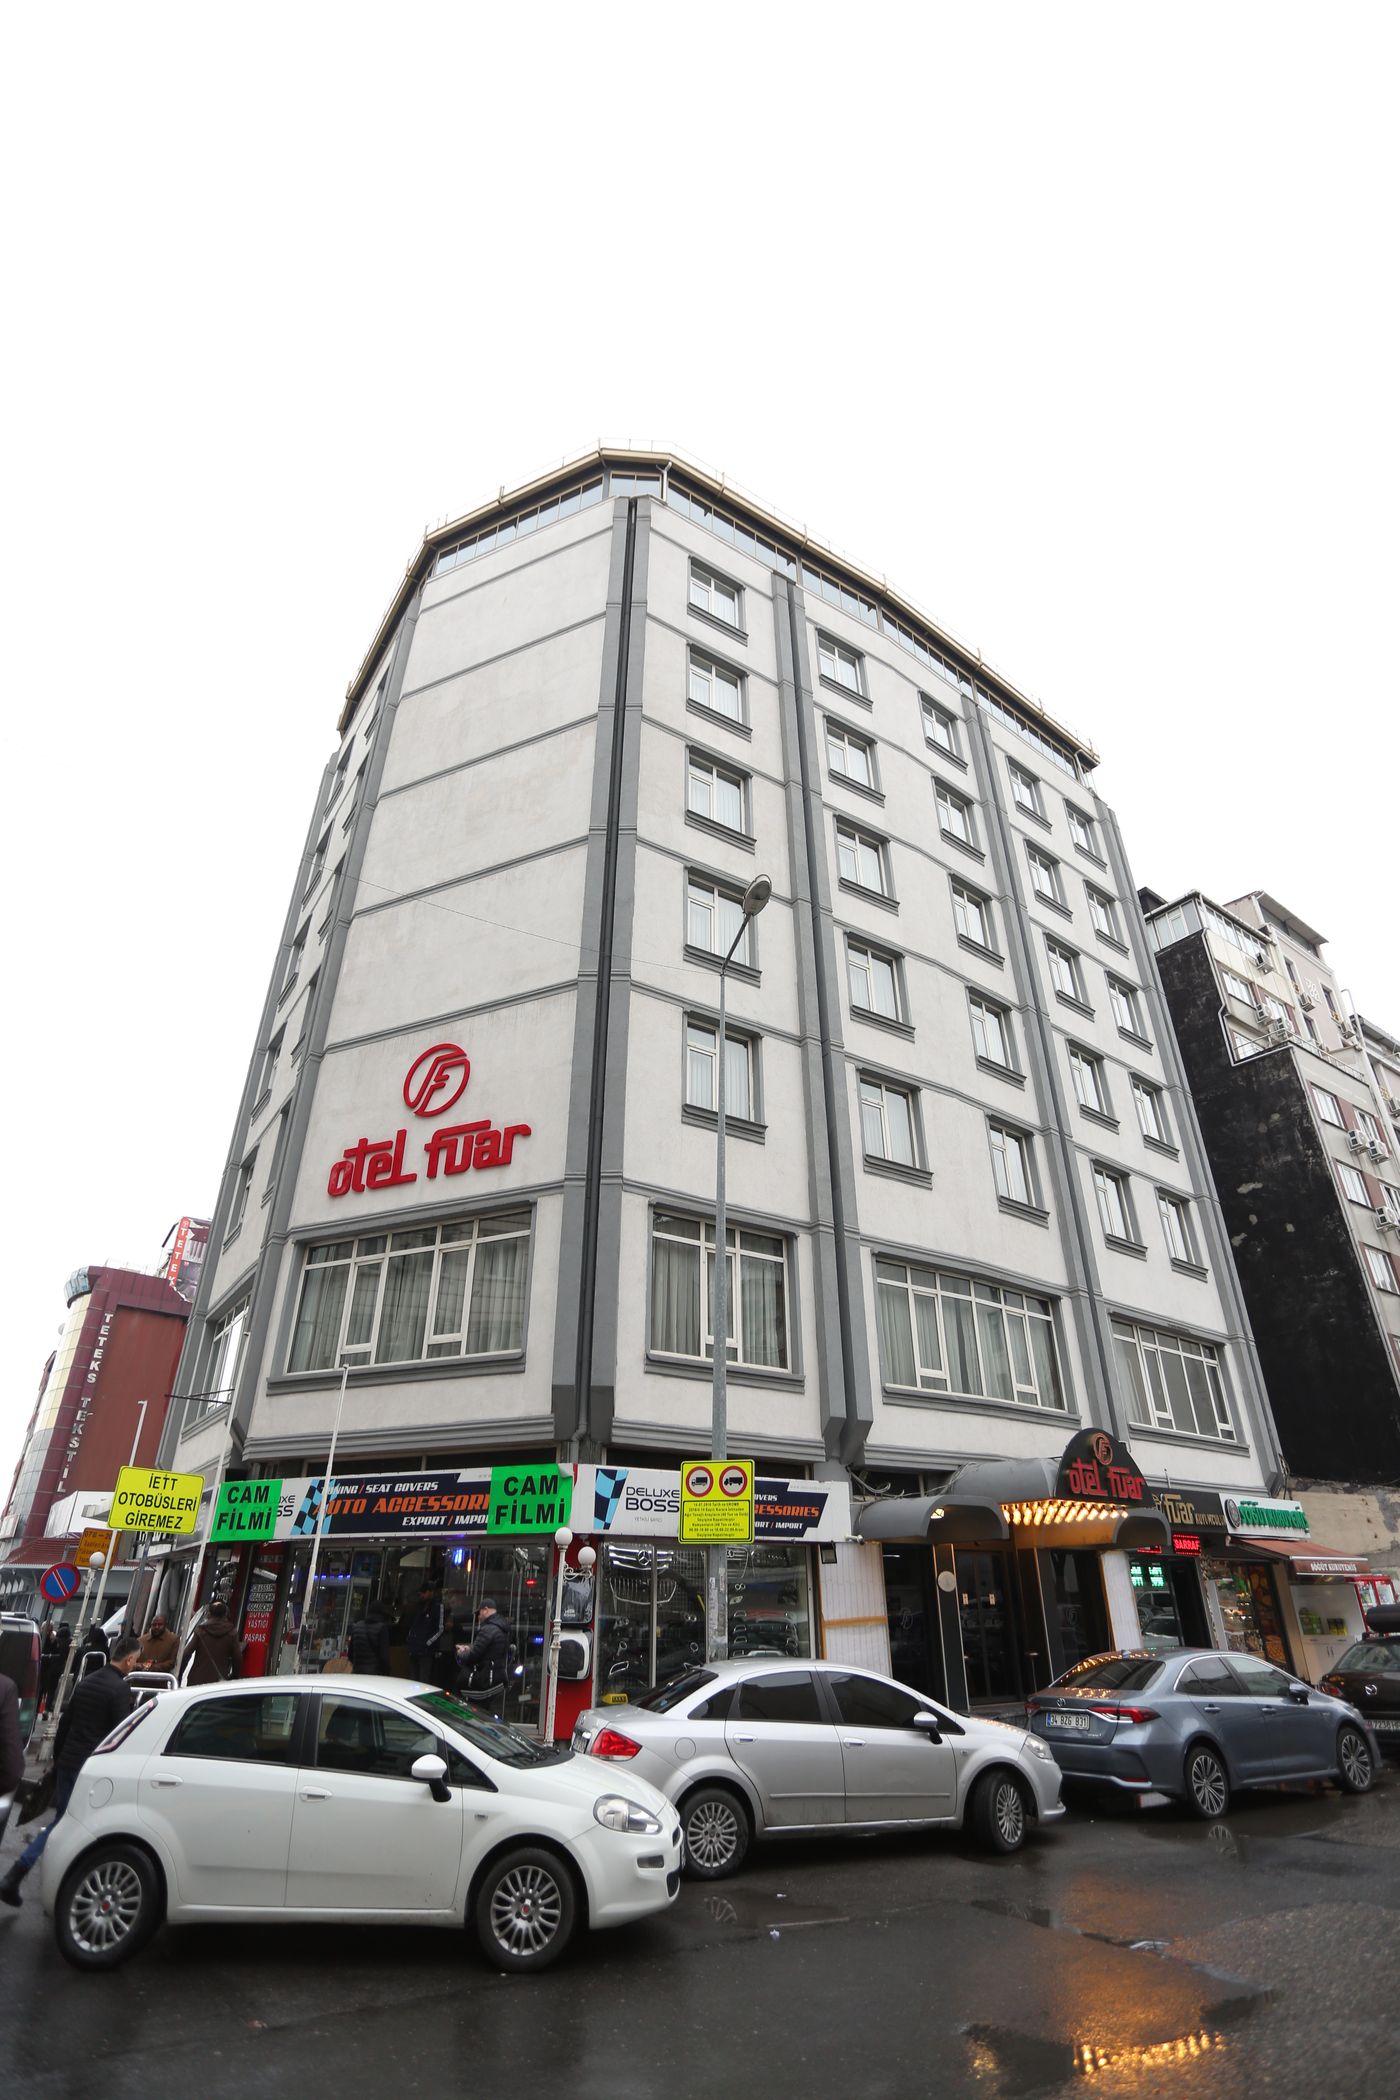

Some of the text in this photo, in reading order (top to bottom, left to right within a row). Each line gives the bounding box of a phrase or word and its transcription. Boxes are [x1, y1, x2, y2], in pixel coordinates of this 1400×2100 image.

[86, 1313, 114, 1384] TETEKS
[148, 1473, 179, 1491] İETT
[365, 1482, 393, 1494] SEAT
[396, 1481, 439, 1492] COVERS
[503, 1475, 559, 1496] CAM
[227, 1485, 270, 1504] CAM
[626, 1486, 681, 1498] DELUXE
[755, 1493, 778, 1502] OVERS
[118, 1491, 198, 1512] OTOBÜSLERİ
[372, 1494, 489, 1514] ACCESSORI
[625, 1497, 680, 1513] BOSS
[125, 1510, 183, 1529] GİREMEZ
[216, 1507, 272, 1530] FİLMİ
[402, 1515, 447, 1526] EXPORT
[454, 1514, 488, 1526] IMPO
[495, 1498, 565, 1526] FİLMİ
[775, 1522, 803, 1530] IMPORT
[1174, 1538, 1200, 1550] SARRAF
[244, 1633, 266, 1642] PASPAS
[1050, 1713, 1058, 1725] 34
[1060, 1715, 1072, 1726] BZG
